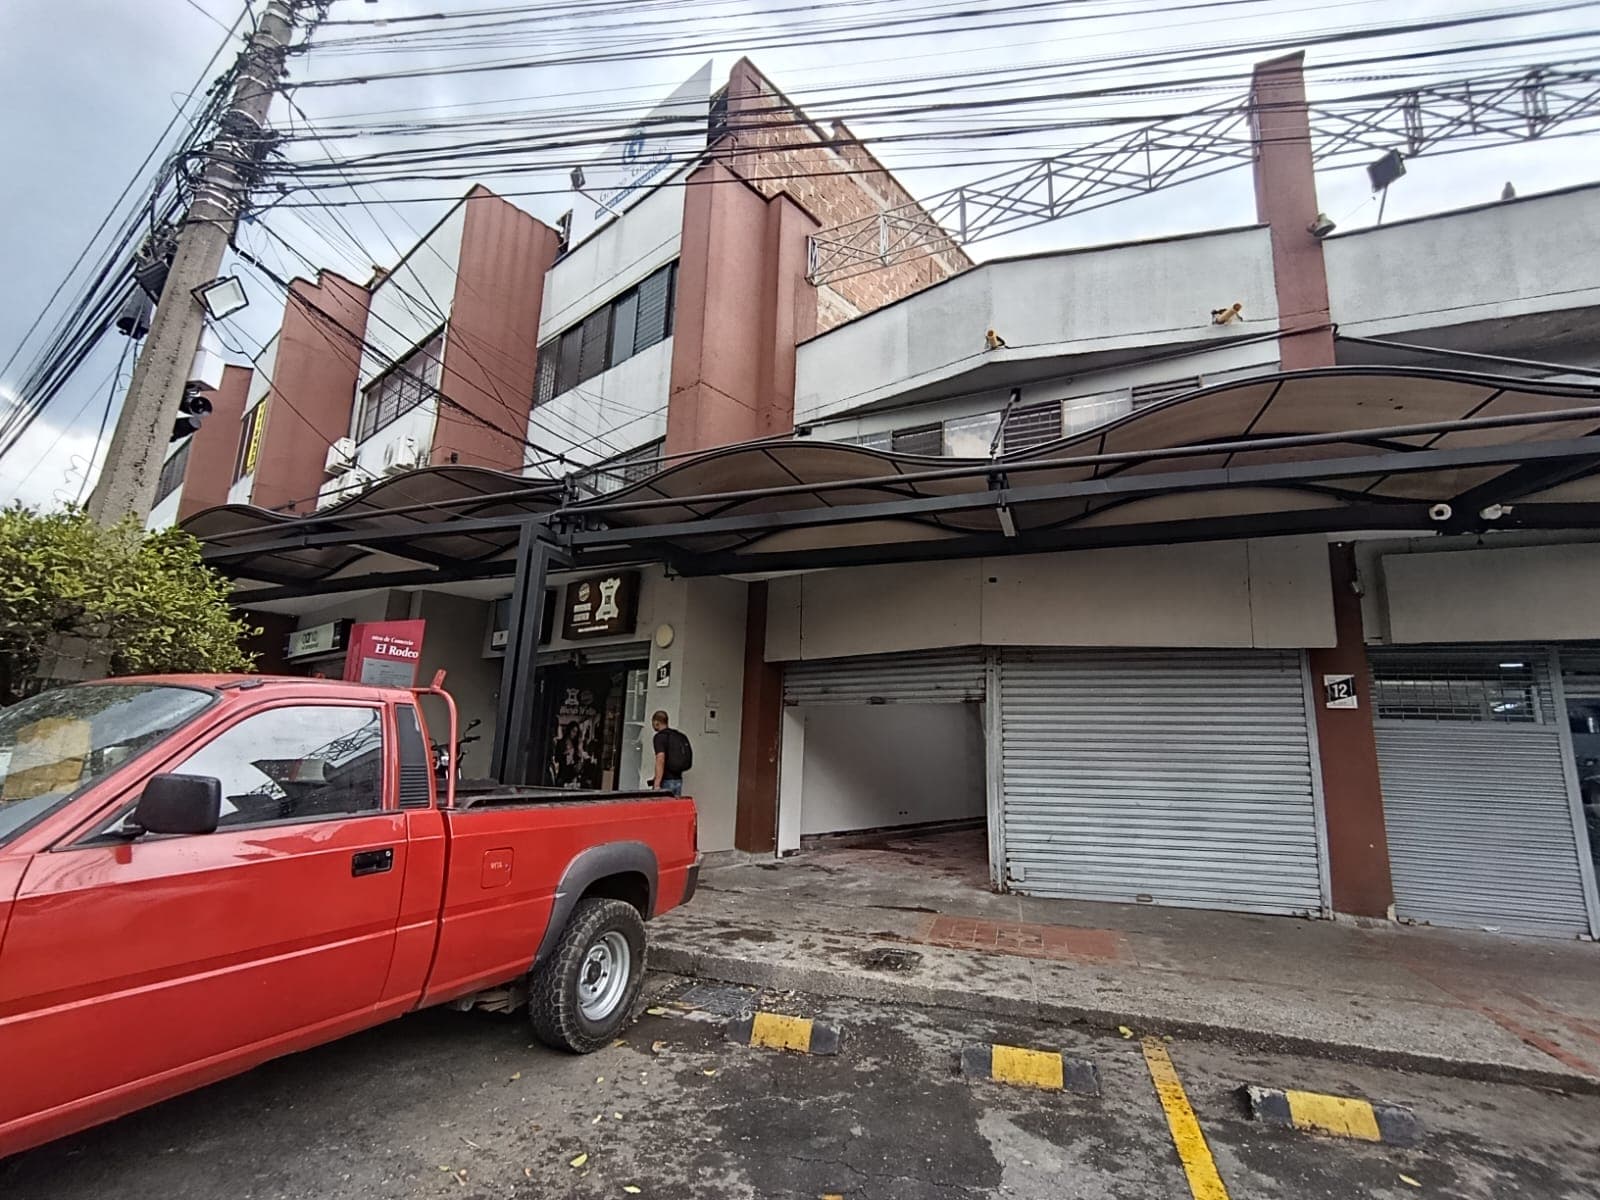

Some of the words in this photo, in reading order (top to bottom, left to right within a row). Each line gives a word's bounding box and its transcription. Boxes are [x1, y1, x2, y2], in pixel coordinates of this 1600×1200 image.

[375, 643, 387, 654] El
[388, 645, 419, 658] Rodeo
[1331, 683, 1348, 698] 12
